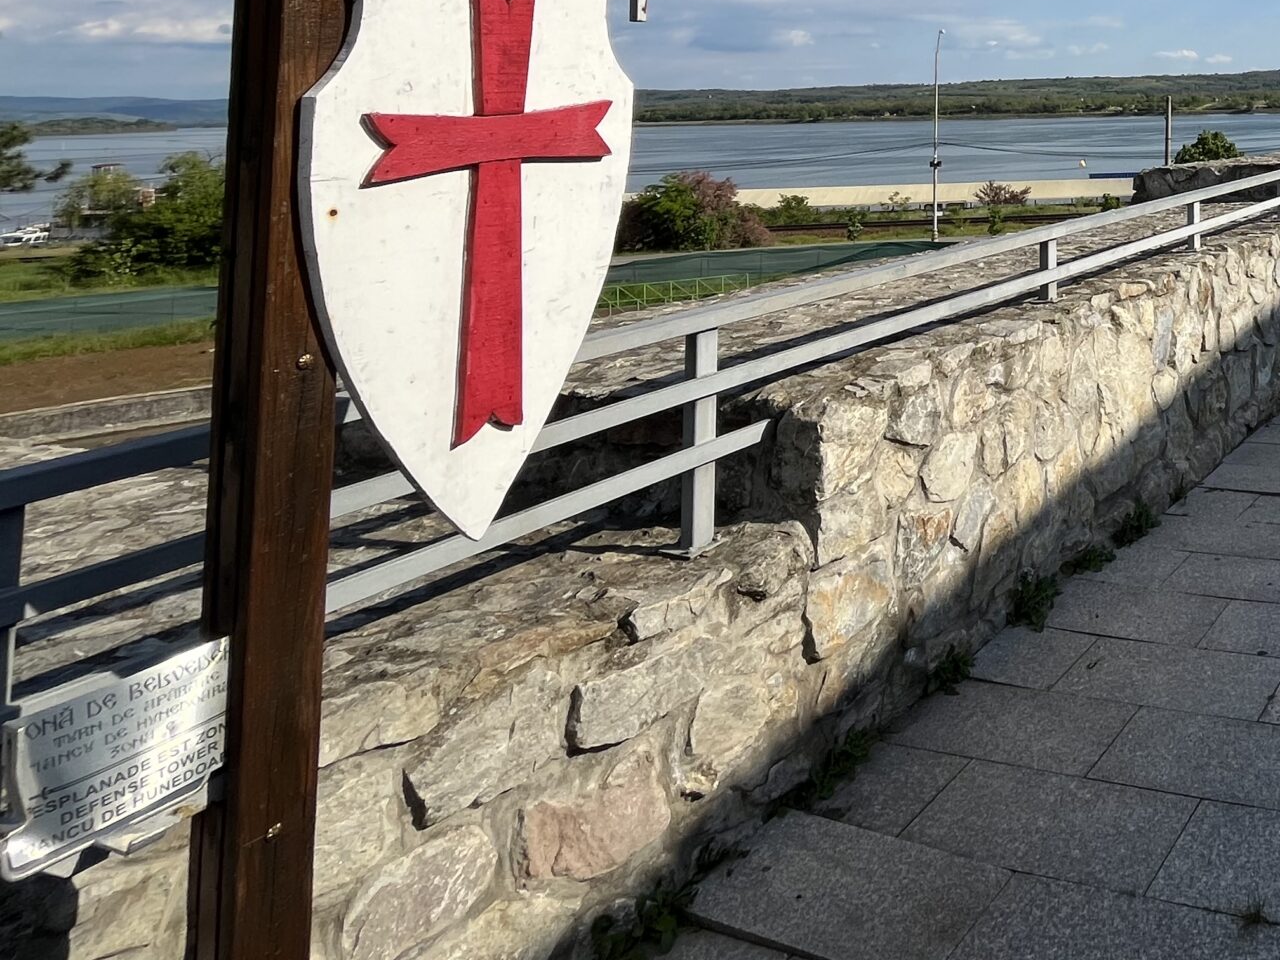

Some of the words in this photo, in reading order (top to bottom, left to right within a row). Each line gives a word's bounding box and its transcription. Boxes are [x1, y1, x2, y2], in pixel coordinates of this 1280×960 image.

[32, 757, 152, 819] ESPLANADE
[157, 738, 192, 764] EST
[195, 723, 226, 746] ZON
[38, 817, 95, 851] ANCU
[101, 802, 128, 824] DE
[132, 752, 226, 809] HUNEDOAR
[59, 775, 150, 826] DEFENSE
[158, 741, 219, 778] TOWER
